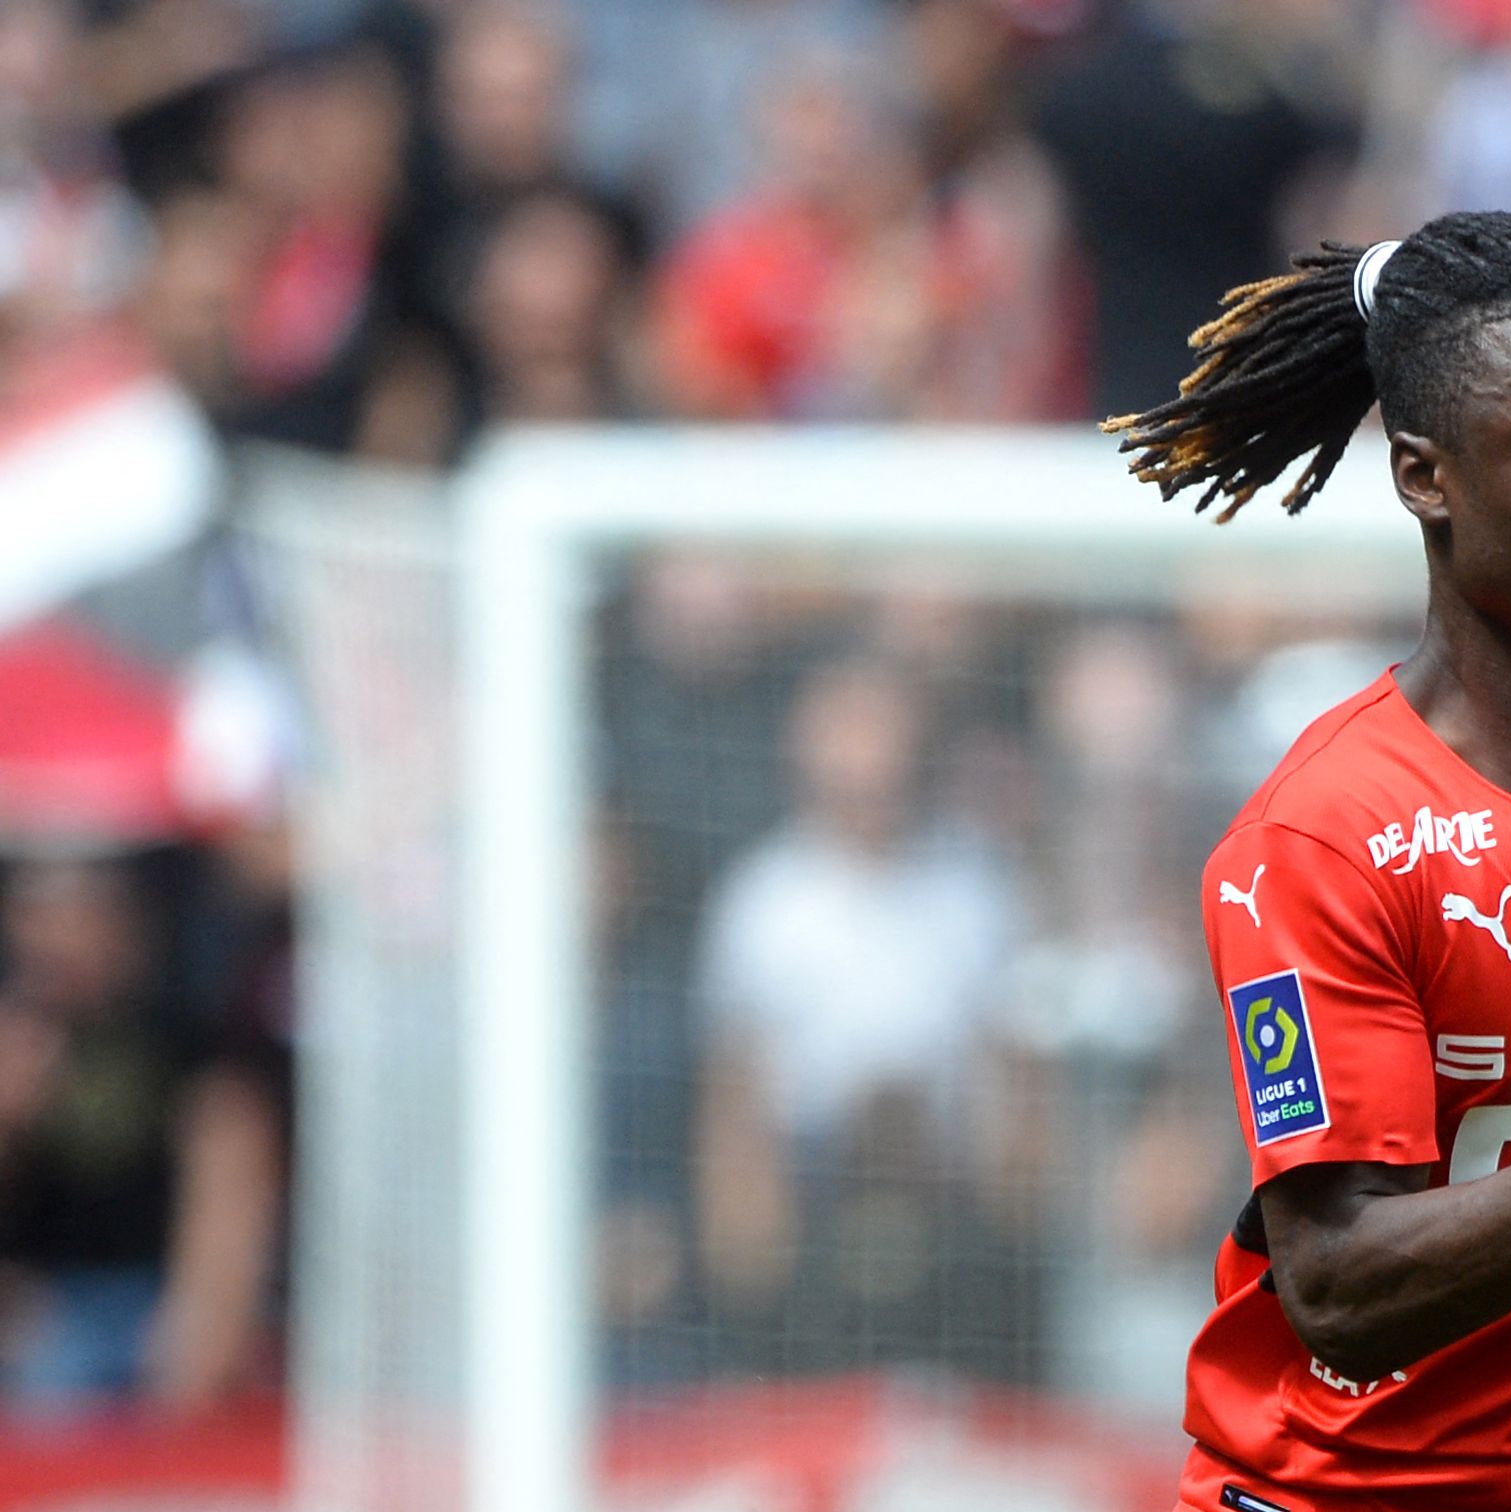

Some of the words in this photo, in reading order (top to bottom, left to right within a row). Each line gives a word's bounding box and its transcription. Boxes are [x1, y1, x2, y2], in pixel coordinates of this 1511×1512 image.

[1256, 1080, 1295, 1105] LIGUE
[1296, 1077, 1307, 1093] 1
[1257, 1109, 1280, 1128] Uber
[1280, 1100, 1315, 1120] Eats
